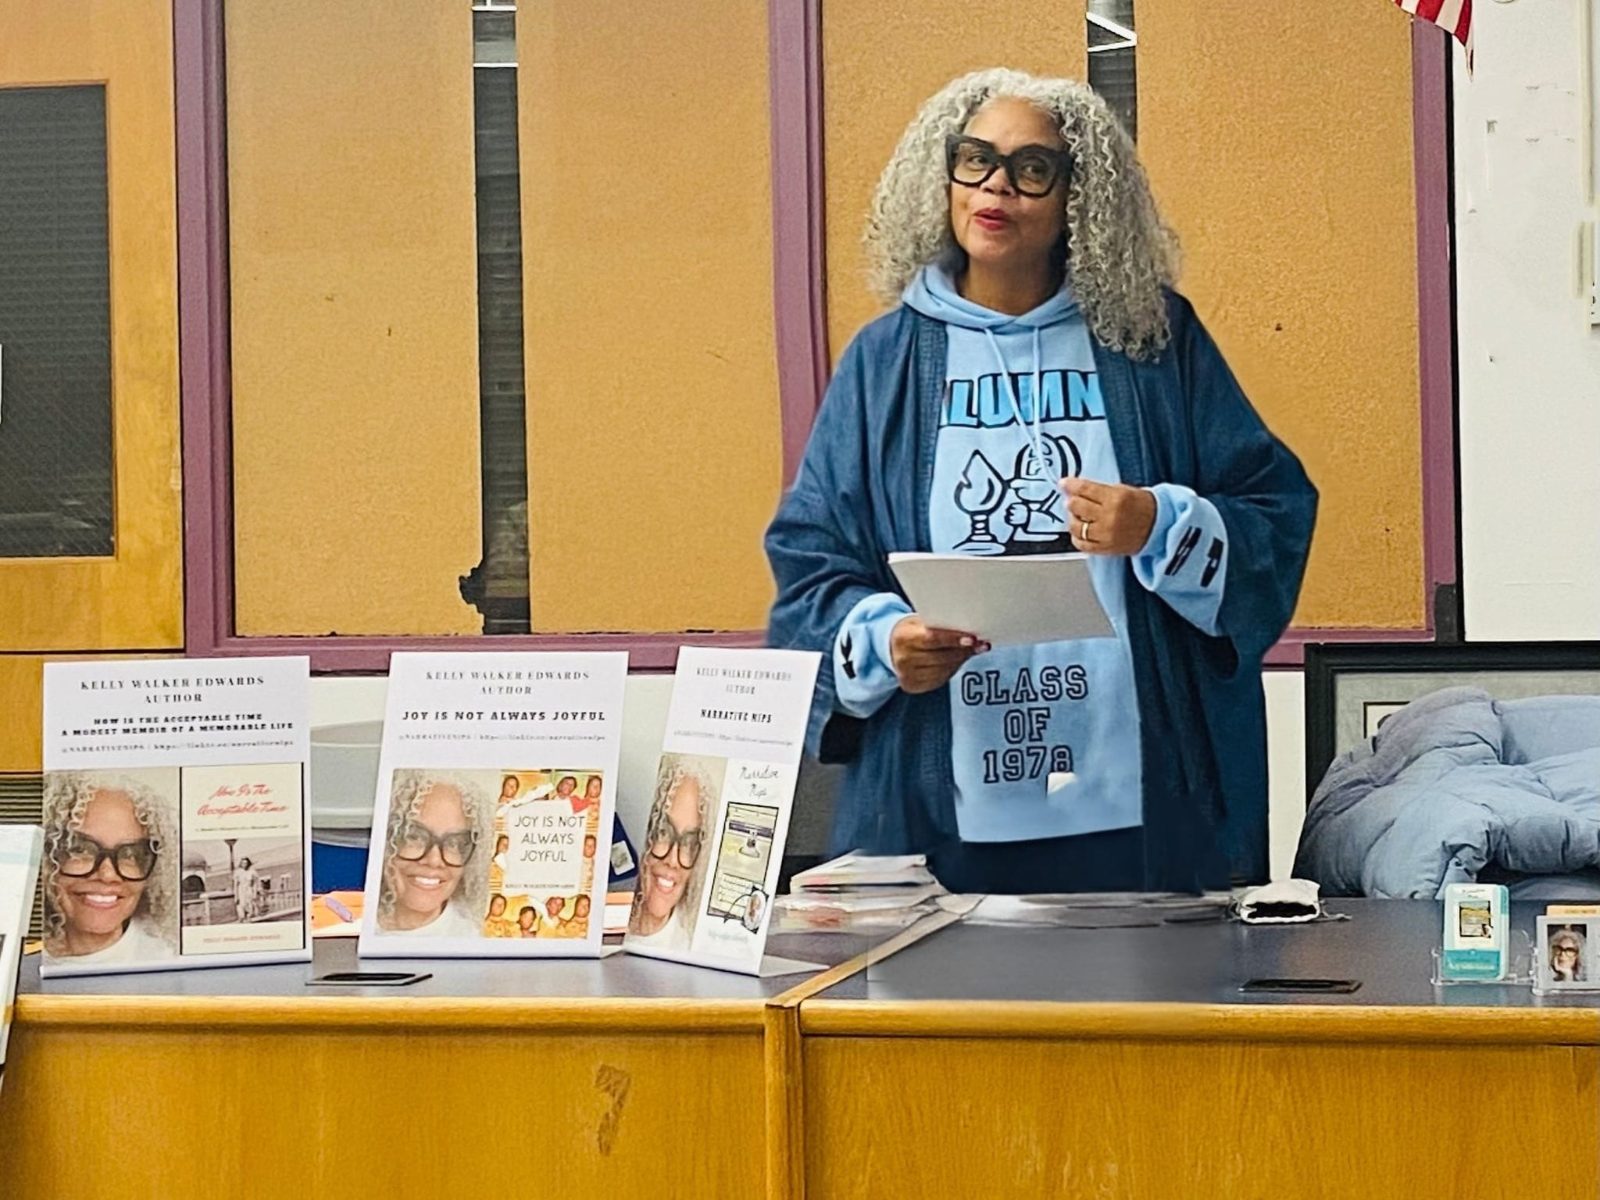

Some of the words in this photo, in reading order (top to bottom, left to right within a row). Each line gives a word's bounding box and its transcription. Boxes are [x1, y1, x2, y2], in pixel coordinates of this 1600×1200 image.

[938, 369, 1106, 429] LUMN
[425, 671, 464, 681] KELLY
[471, 671, 522, 681] WALKER
[528, 671, 590, 681] EDWARDS
[81, 680, 124, 690] KELLY
[132, 678, 190, 689] WALKER
[196, 676, 264, 688] EDWARDS
[961, 664, 1088, 706] CLASS
[482, 685, 532, 695] AUTHOR
[146, 693, 202, 703] AUTHOR
[163, 714, 231, 723] ACCEPTABLE
[235, 713, 262, 721] TIME
[402, 711, 429, 721] JOY
[435, 711, 448, 721] IS
[455, 711, 484, 721] NOT
[490, 711, 546, 721] ALWAYS
[552, 711, 605, 721] JOYFUL
[700, 708, 748, 722] NARRATIVE
[751, 712, 773, 723] NIPS
[73, 728, 117, 736] MODEST
[122, 726, 167, 735] MEMOIR
[200, 723, 266, 732] MEMORABLE
[270, 722, 293, 730] LIFE
[1003, 707, 1051, 744] OF
[983, 745, 1074, 784] 1978
[514, 815, 539, 828] JOY
[542, 815, 553, 828] IS
[558, 815, 585, 828] NOT
[521, 833, 575, 845] ALWAYS
[520, 850, 567, 862] JOYFUL
